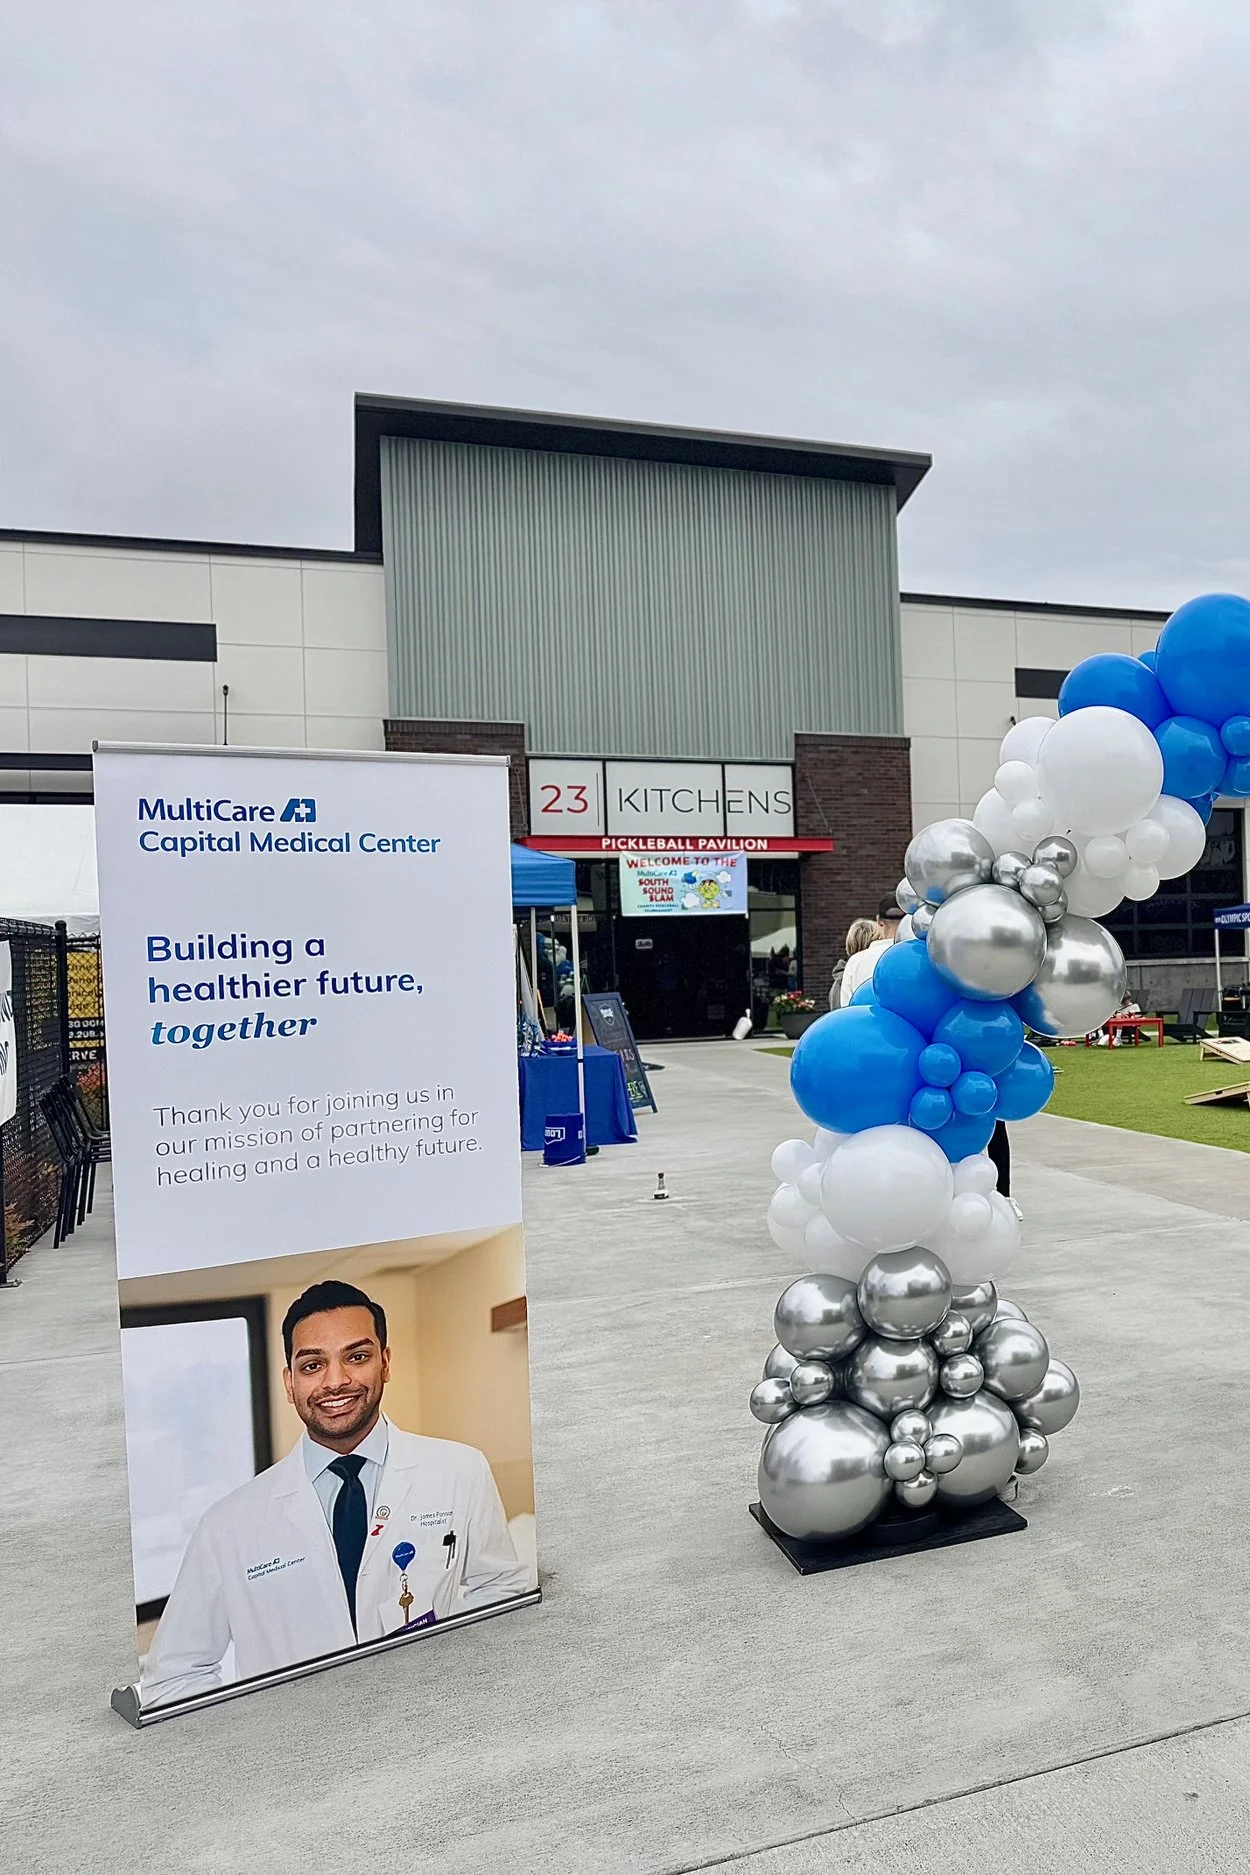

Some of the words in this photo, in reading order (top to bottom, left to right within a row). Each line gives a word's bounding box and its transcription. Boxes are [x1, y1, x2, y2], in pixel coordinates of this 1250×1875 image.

[138, 797, 275, 822] MultiCare
[540, 785, 589, 814] 23
[618, 787, 792, 815] KITCHENS
[139, 831, 240, 857] Capital
[250, 832, 350, 853] Medical
[359, 833, 441, 853] Center
[601, 838, 697, 850] PICKLEBALL
[698, 839, 768, 850] PAVILION
[626, 857, 690, 869] WELCOME
[692, 857, 709, 866] TO
[713, 857, 737, 868] THE
[638, 878, 669, 886] SOUTH
[642, 887, 674, 895] SOUND
[649, 894, 674, 902] SLAM
[147, 934, 293, 965] Building
[305, 938, 326, 956] a
[149, 973, 306, 1004] healthier
[316, 970, 424, 996] future,
[151, 1012, 318, 1050] together
[153, 1102, 232, 1127] Thank
[238, 1099, 281, 1124] you
[287, 1096, 321, 1115] for
[324, 1091, 399, 1116] joining
[406, 1088, 430, 1104] us
[436, 1084, 454, 1101] in
[155, 1137, 197, 1157] our
[204, 1127, 293, 1151] mission
[301, 1121, 324, 1142] of
[331, 1113, 444, 1143] partnering
[449, 1108, 479, 1127] for
[157, 1160, 247, 1187] healing
[254, 1152, 298, 1174] and
[306, 1155, 320, 1169] a
[329, 1142, 410, 1167] healthy
[415, 1136, 483, 1157] future.
